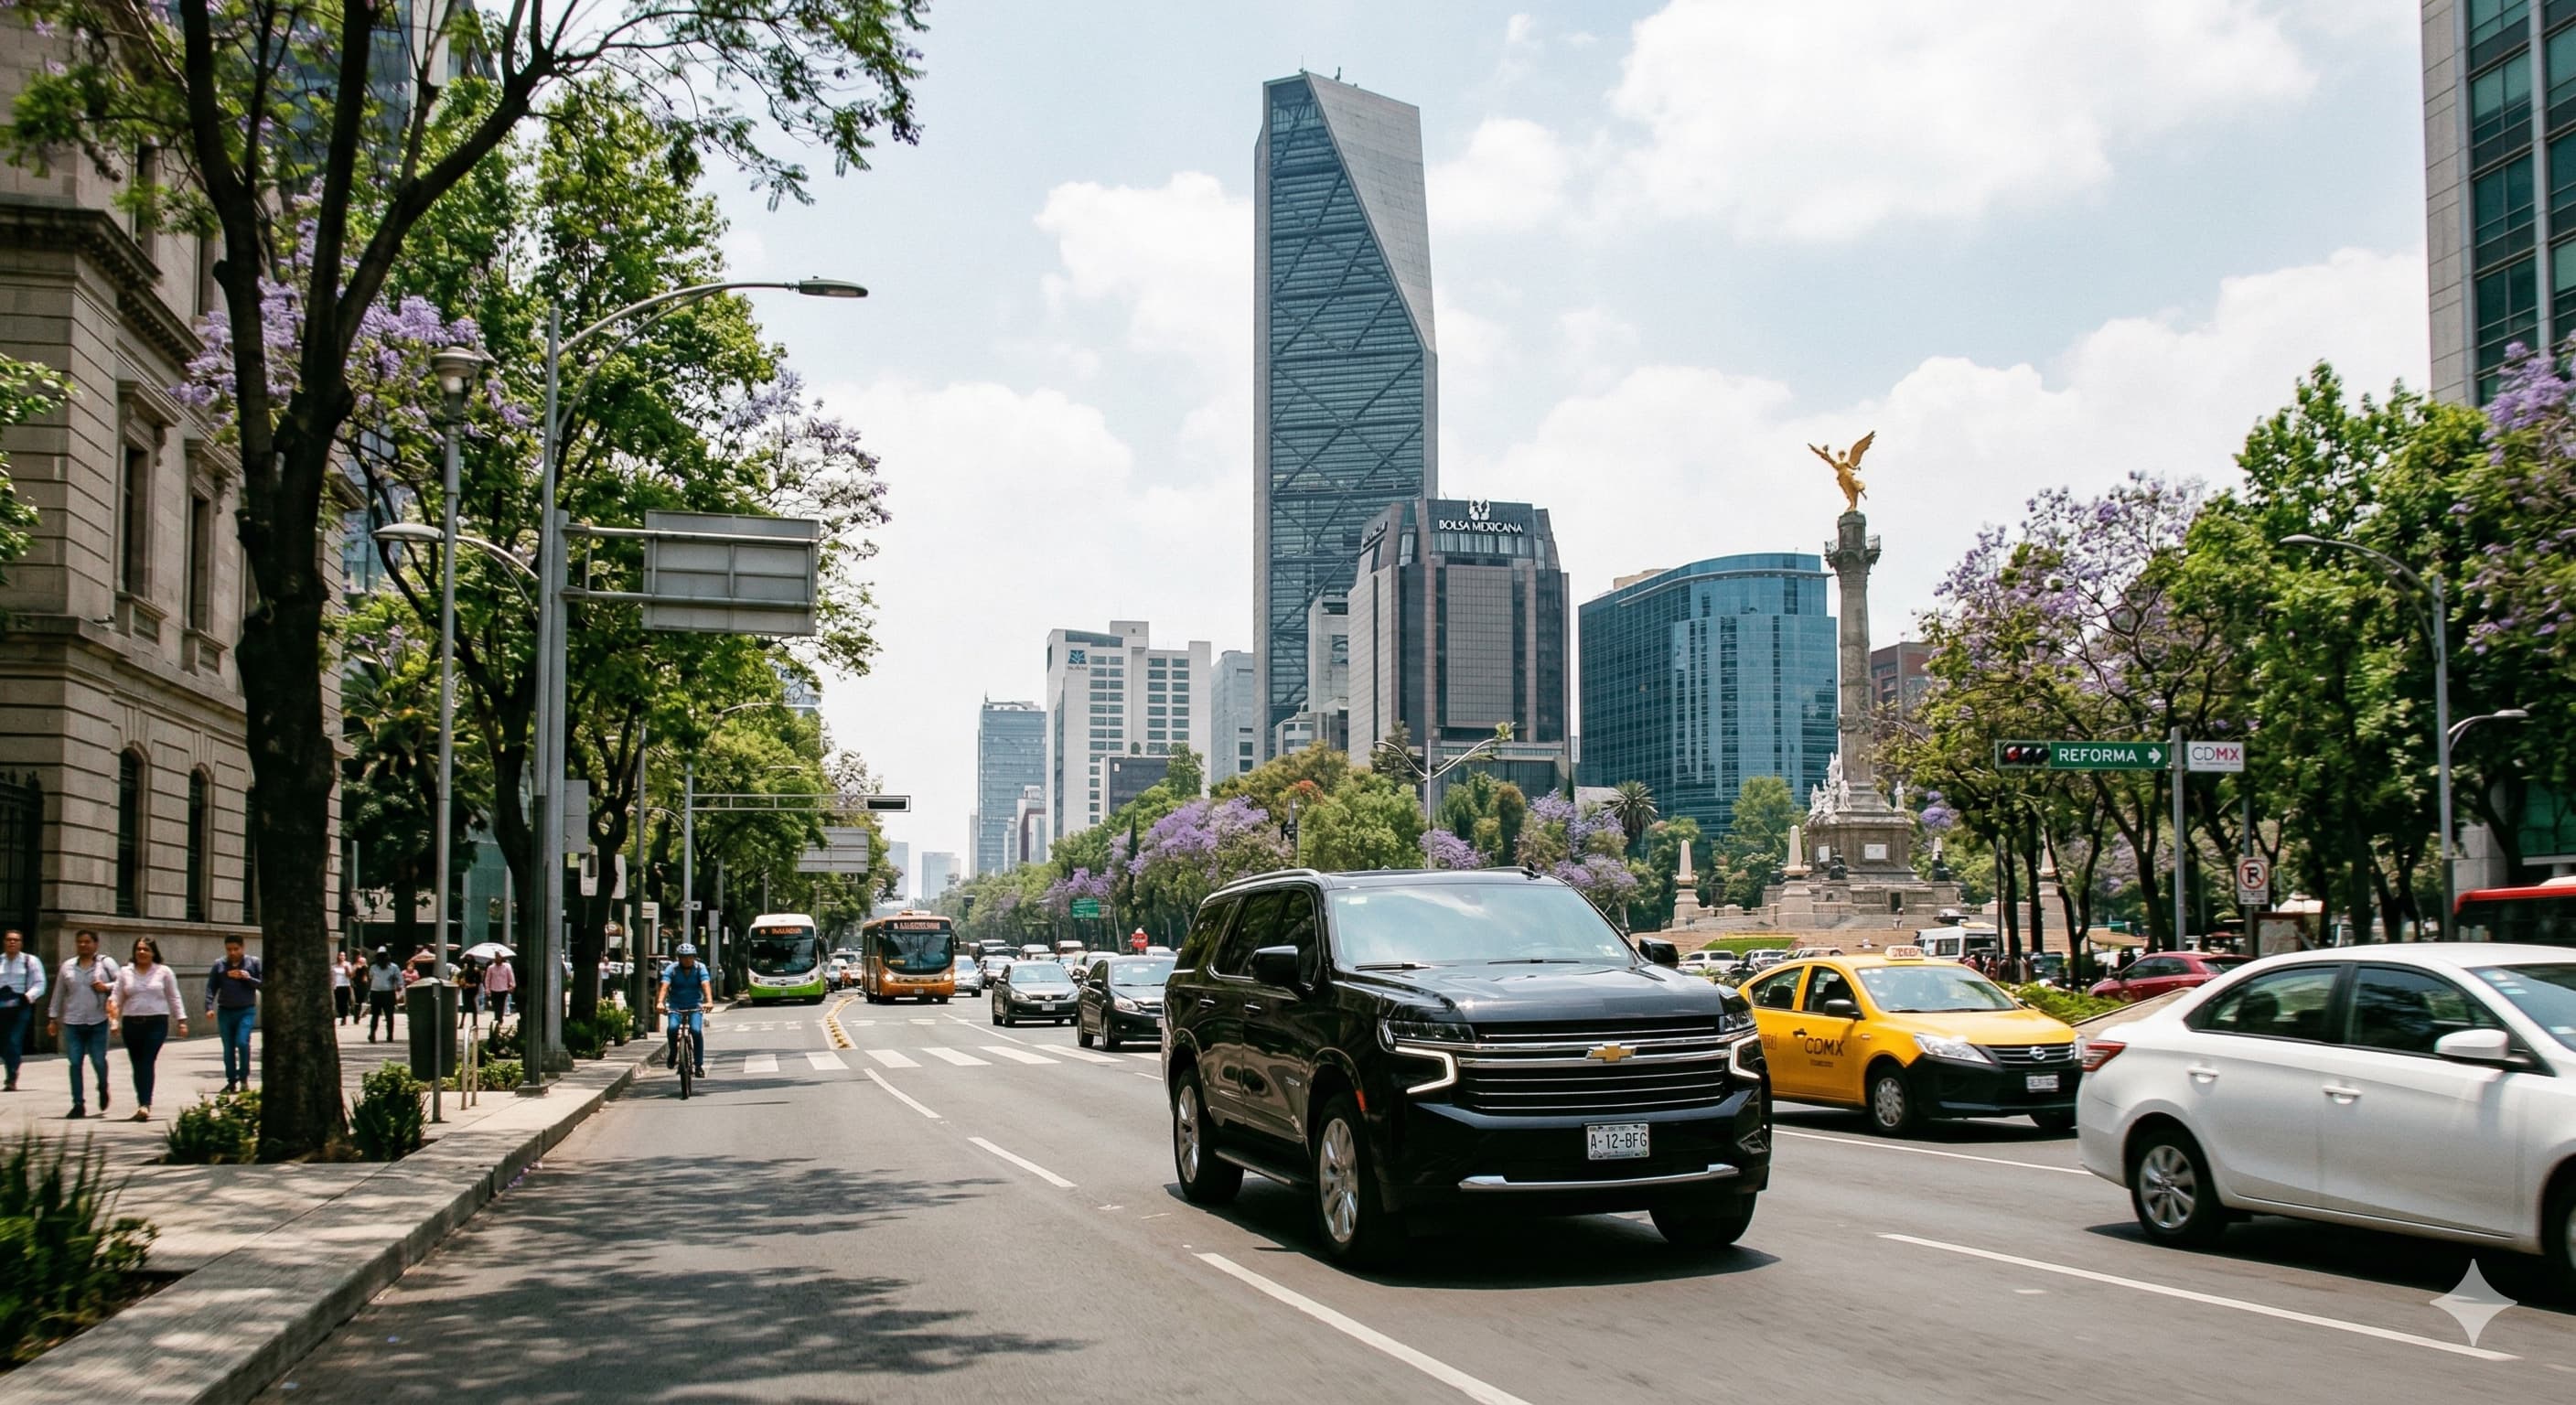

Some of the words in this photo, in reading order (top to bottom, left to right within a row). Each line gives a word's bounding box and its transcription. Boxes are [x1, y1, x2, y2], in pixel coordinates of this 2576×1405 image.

[1439, 520, 1470, 531] BOLSA
[1472, 521, 1523, 533] MEXICANA
[2058, 748, 2138, 762] REFORMA
[2192, 746, 2240, 761] CDMX
[1590, 1132, 1648, 1150] A-12-BFG
